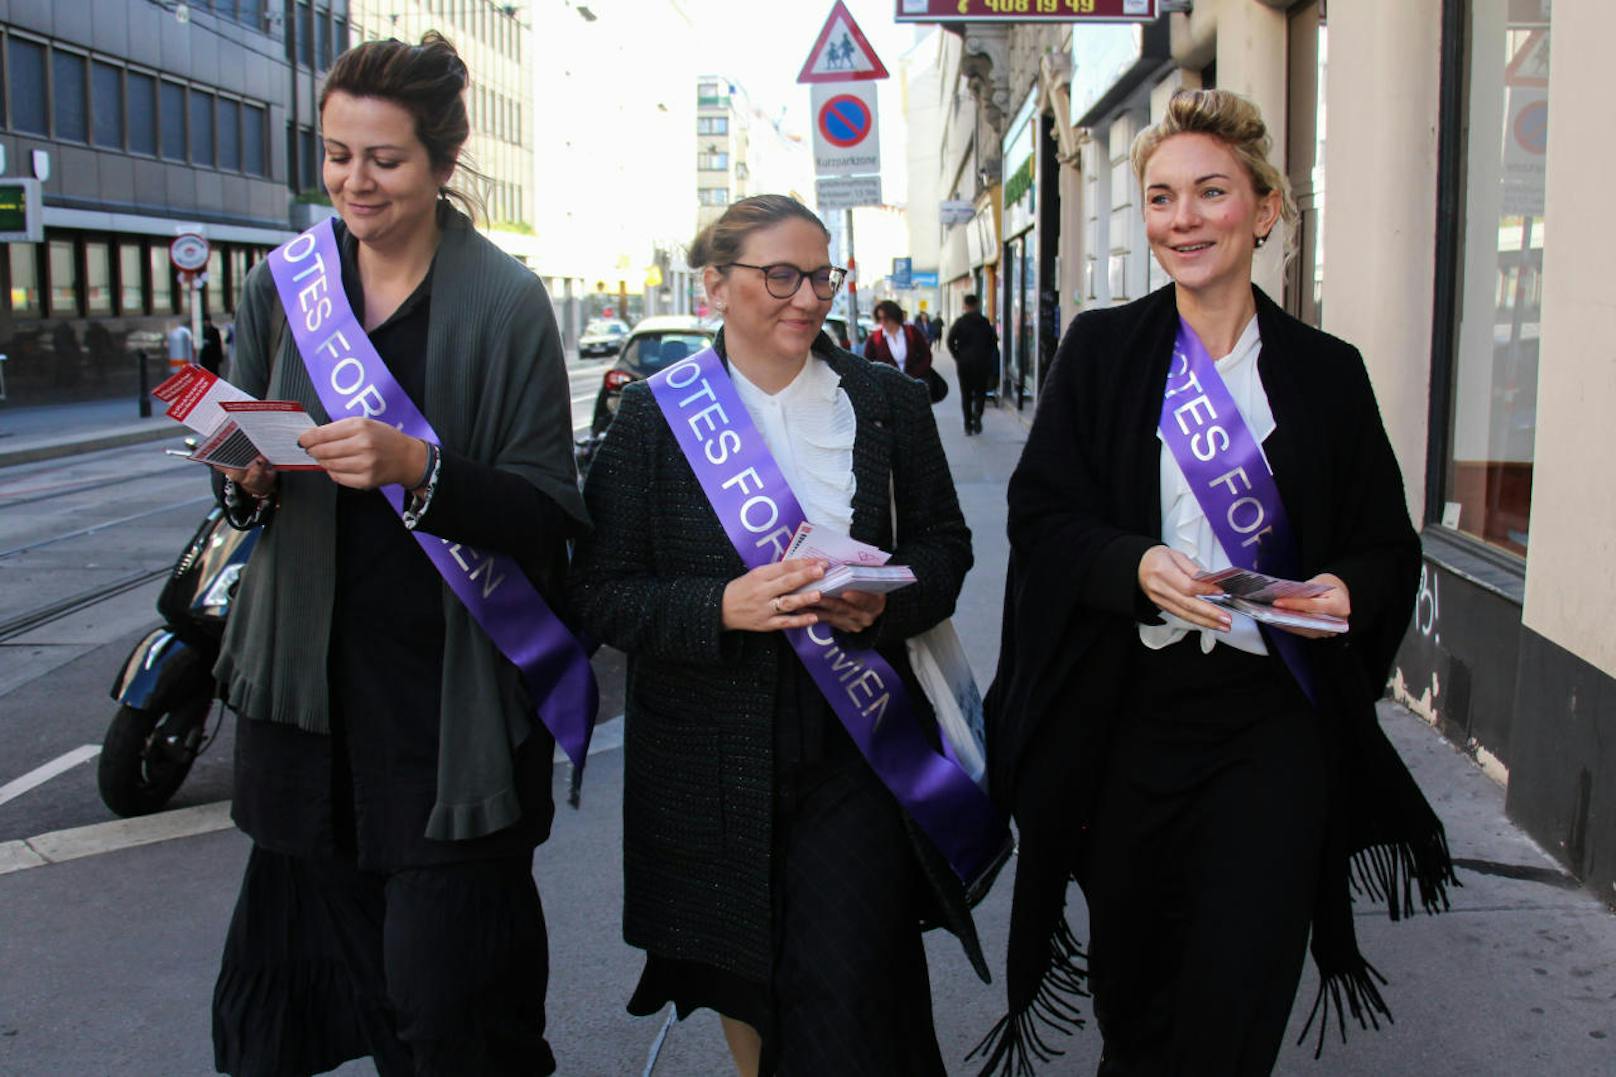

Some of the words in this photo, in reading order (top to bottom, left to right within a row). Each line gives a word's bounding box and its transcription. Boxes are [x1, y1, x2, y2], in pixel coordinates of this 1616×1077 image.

[984, 0, 1029, 13] 408
[1036, 0, 1059, 13] 19
[1064, 0, 1096, 13] 49
[315, 329, 387, 419] FOR
[665, 360, 742, 465] OTES
[1165, 349, 1231, 462] OTES
[806, 619, 891, 733] OMEN
